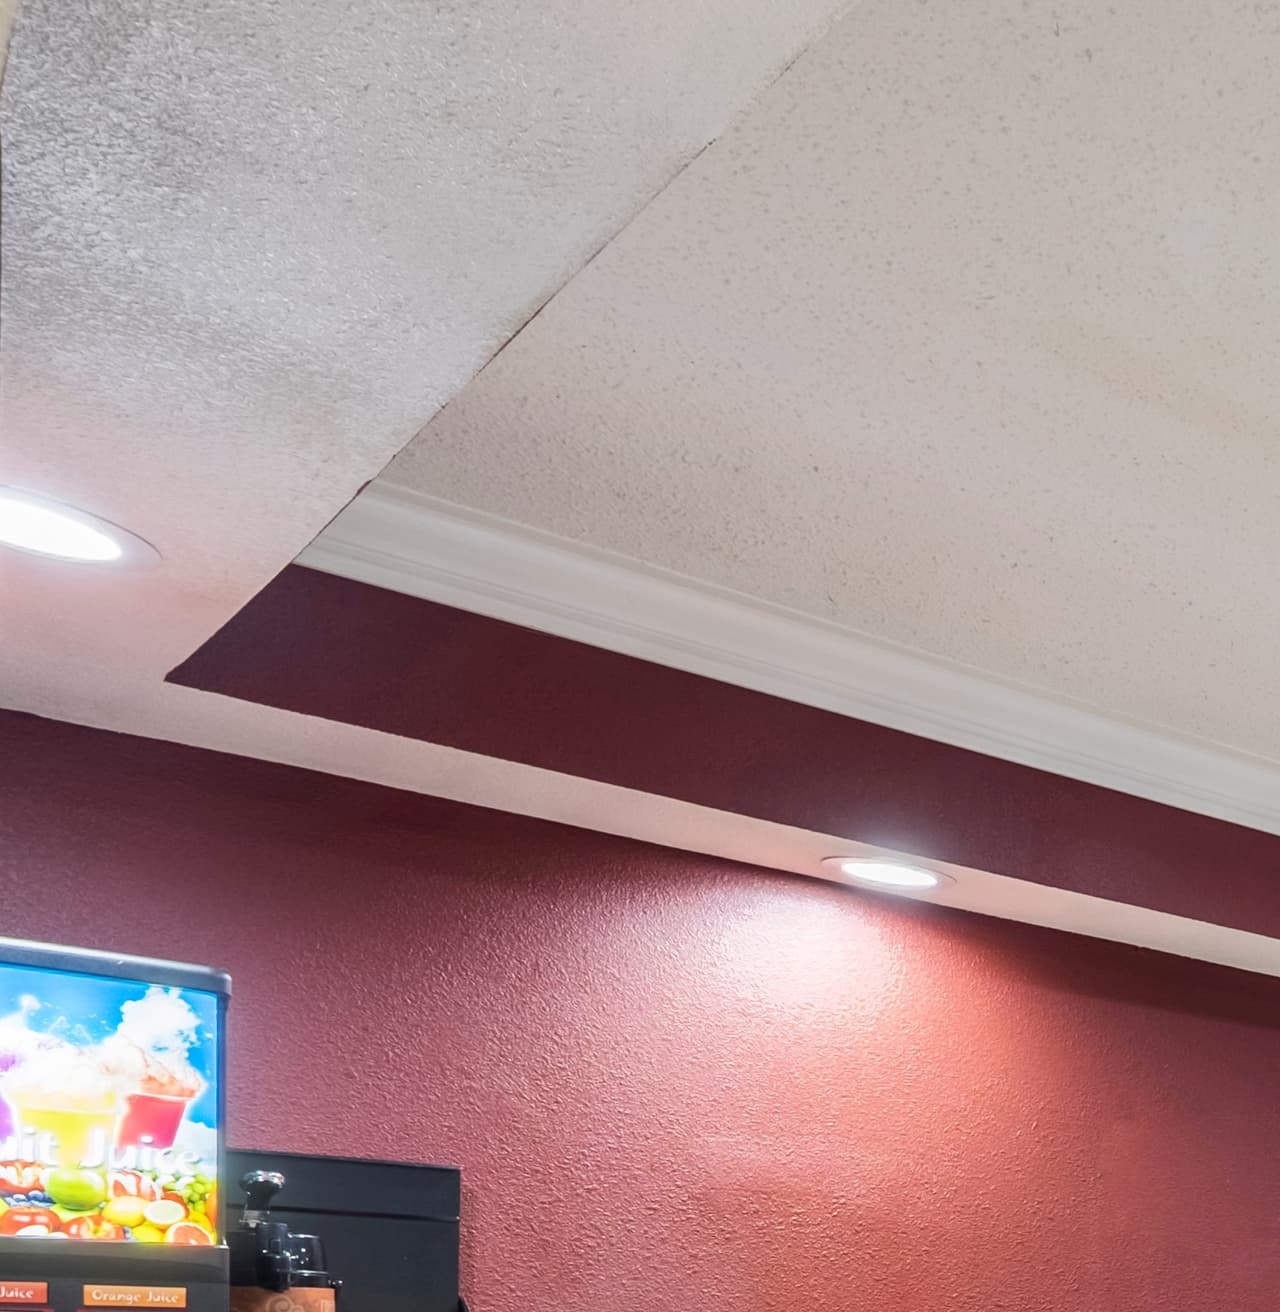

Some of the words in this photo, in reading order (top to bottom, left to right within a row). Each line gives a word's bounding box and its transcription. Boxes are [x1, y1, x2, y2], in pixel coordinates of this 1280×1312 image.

[79, 1127, 201, 1177] Juice
[0, 1286, 34, 1299] Juice
[92, 1290, 140, 1305] Orange
[146, 1291, 179, 1303] Juice
